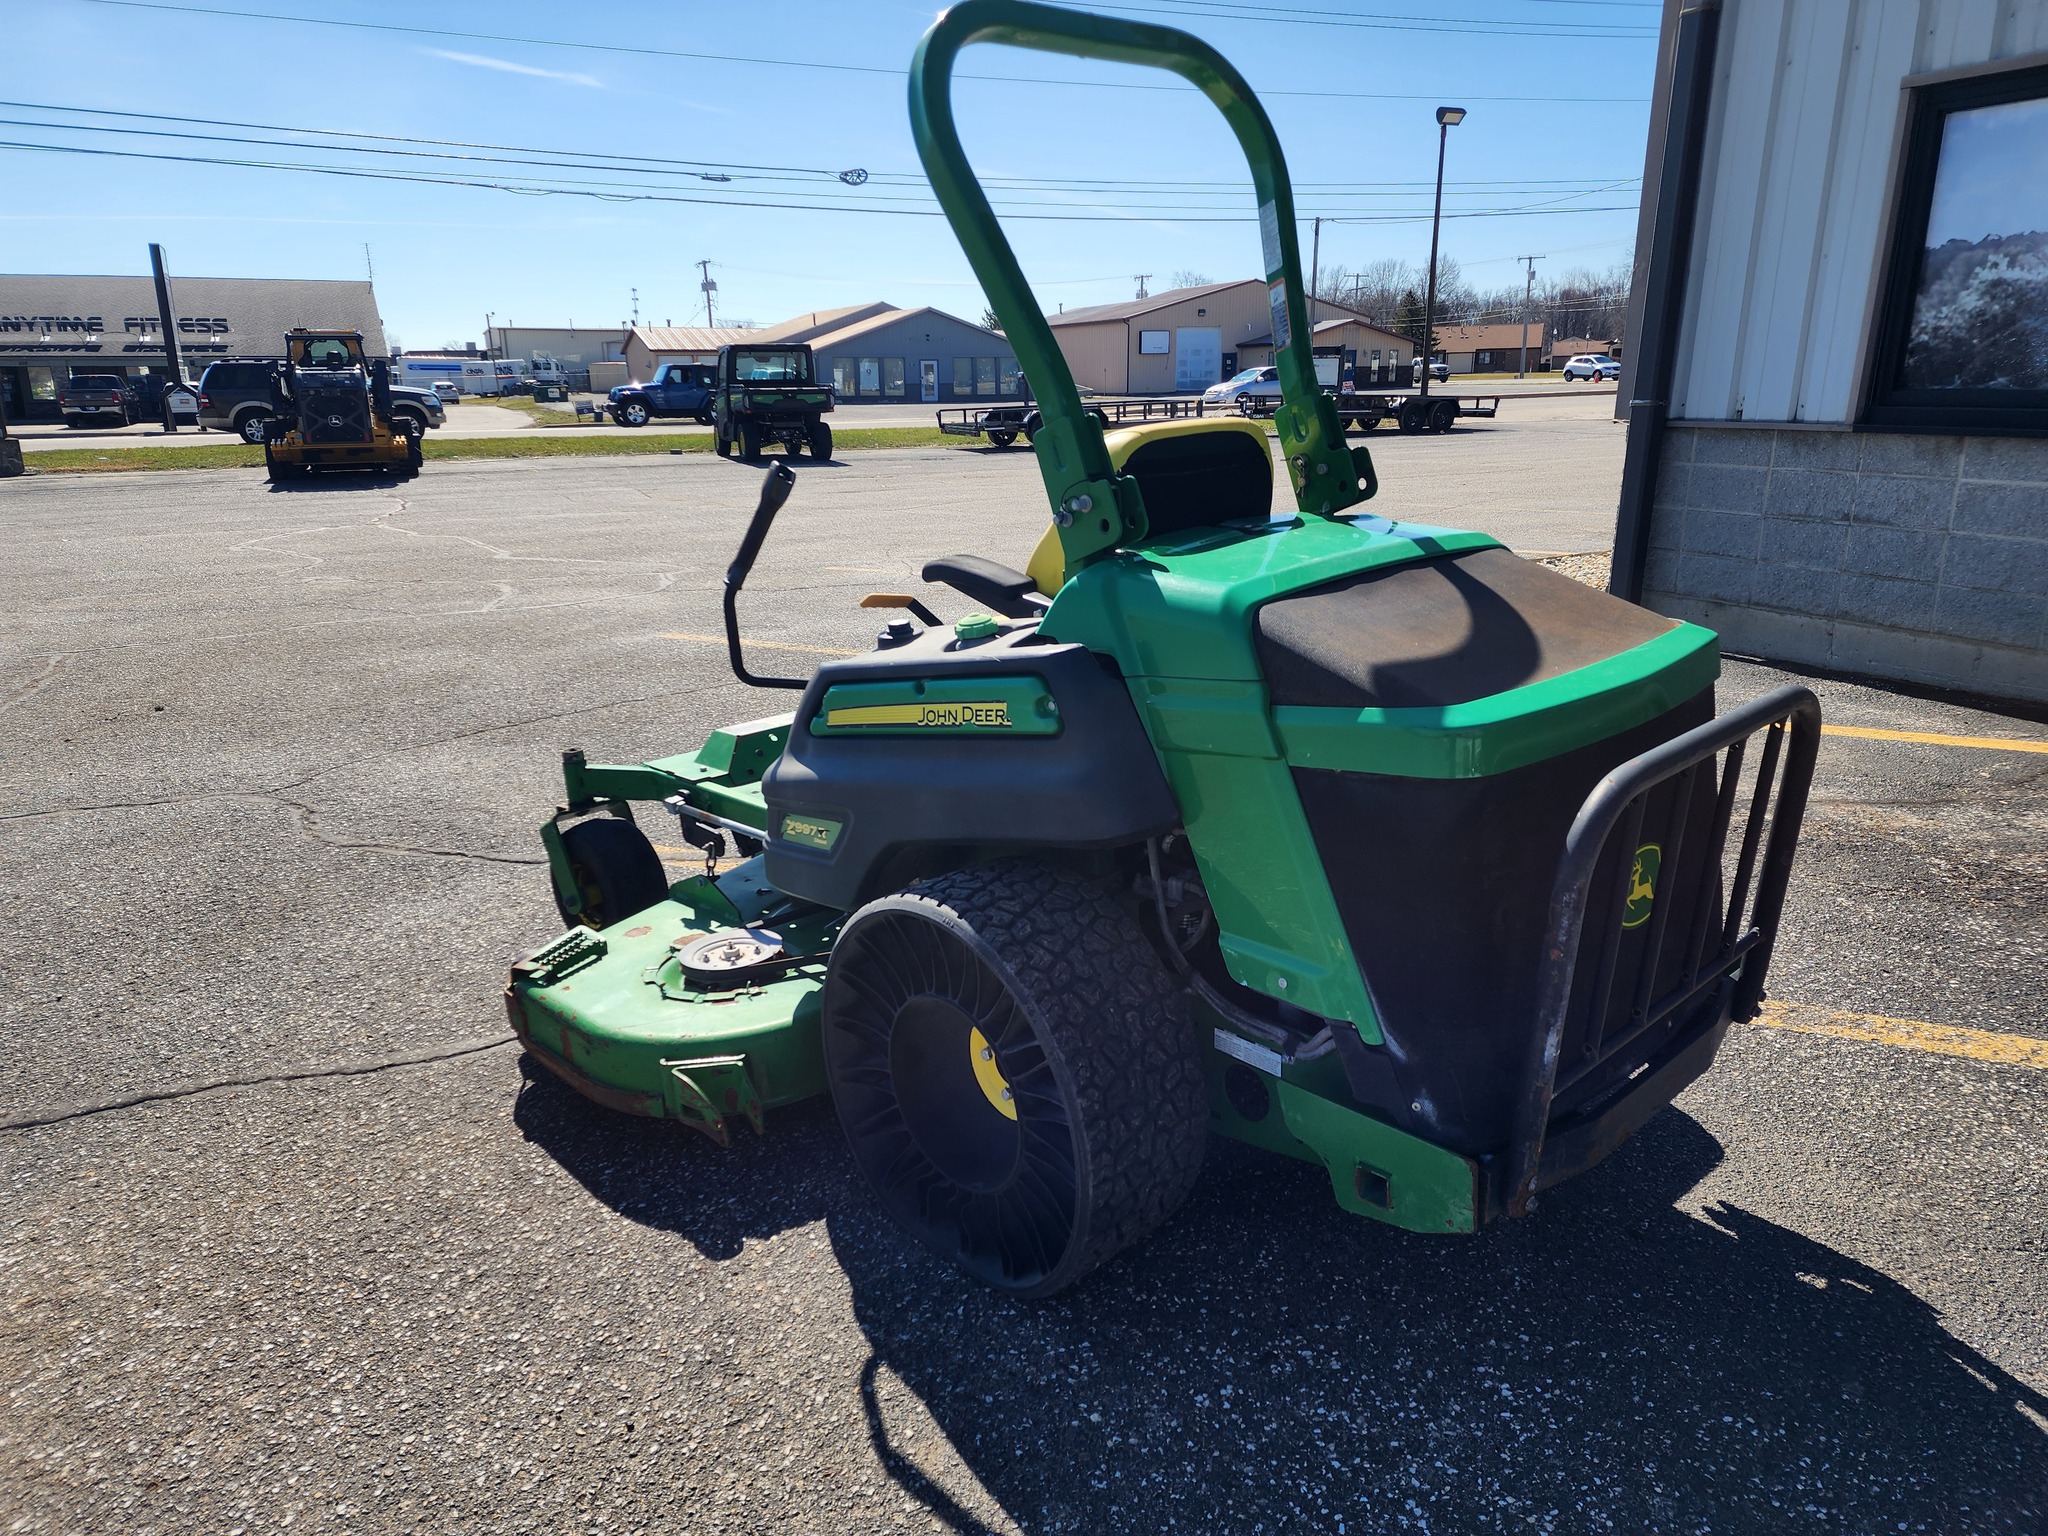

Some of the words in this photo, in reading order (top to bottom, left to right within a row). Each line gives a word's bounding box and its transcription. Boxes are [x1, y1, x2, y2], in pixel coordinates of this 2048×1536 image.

[0, 316, 104, 332] NYTIME
[123, 317, 229, 333] FITESS
[917, 707, 958, 723] JOHN
[962, 706, 1011, 723] DEER
